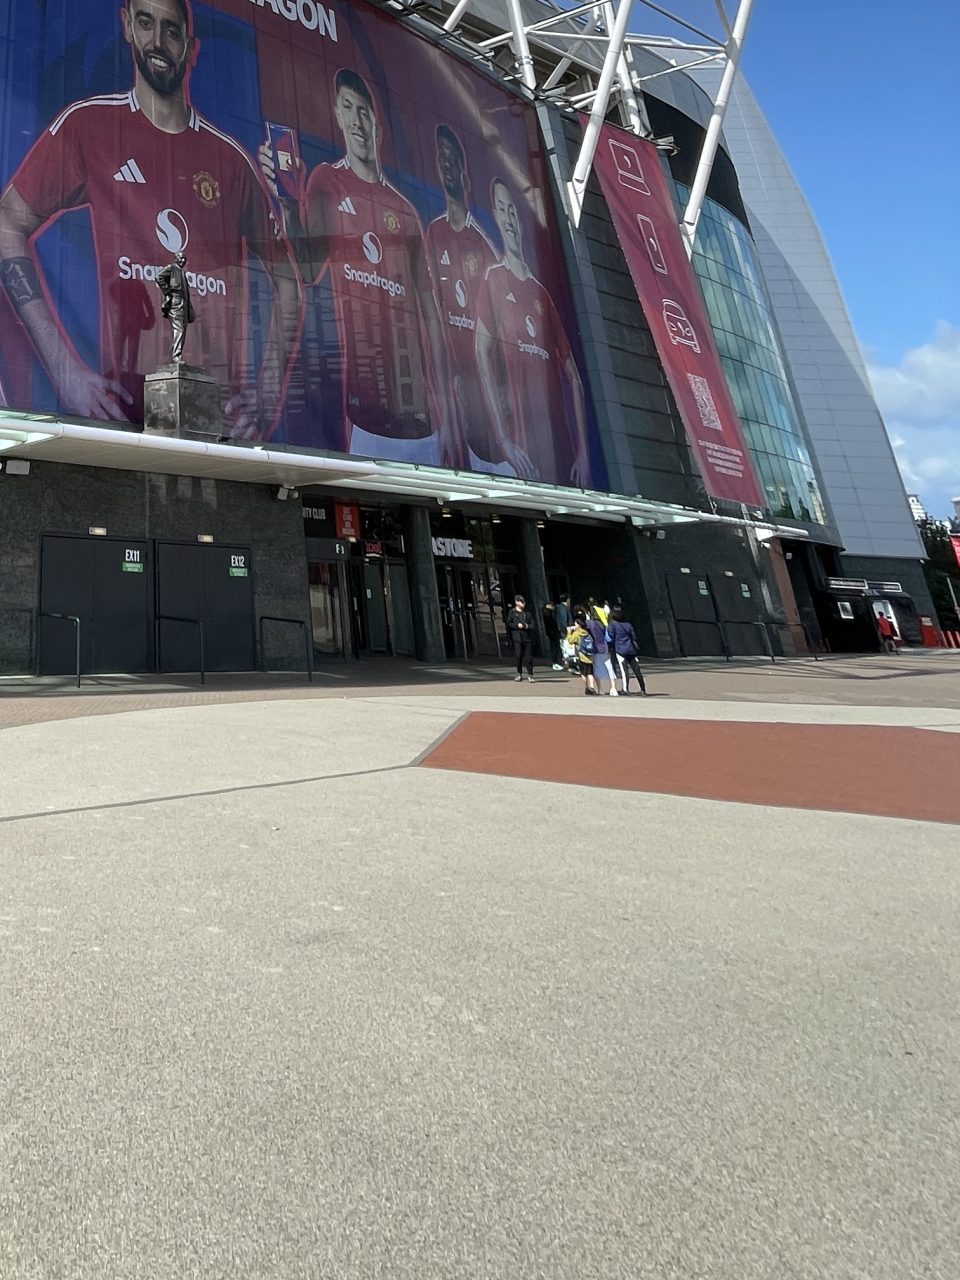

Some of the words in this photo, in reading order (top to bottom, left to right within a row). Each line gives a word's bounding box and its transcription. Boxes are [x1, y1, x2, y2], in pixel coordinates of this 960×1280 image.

[344, 263, 406, 297] Snapdragon
[312, 507, 327, 520] CLUB
[125, 548, 140, 563] EX11
[230, 555, 245, 568] EX12
